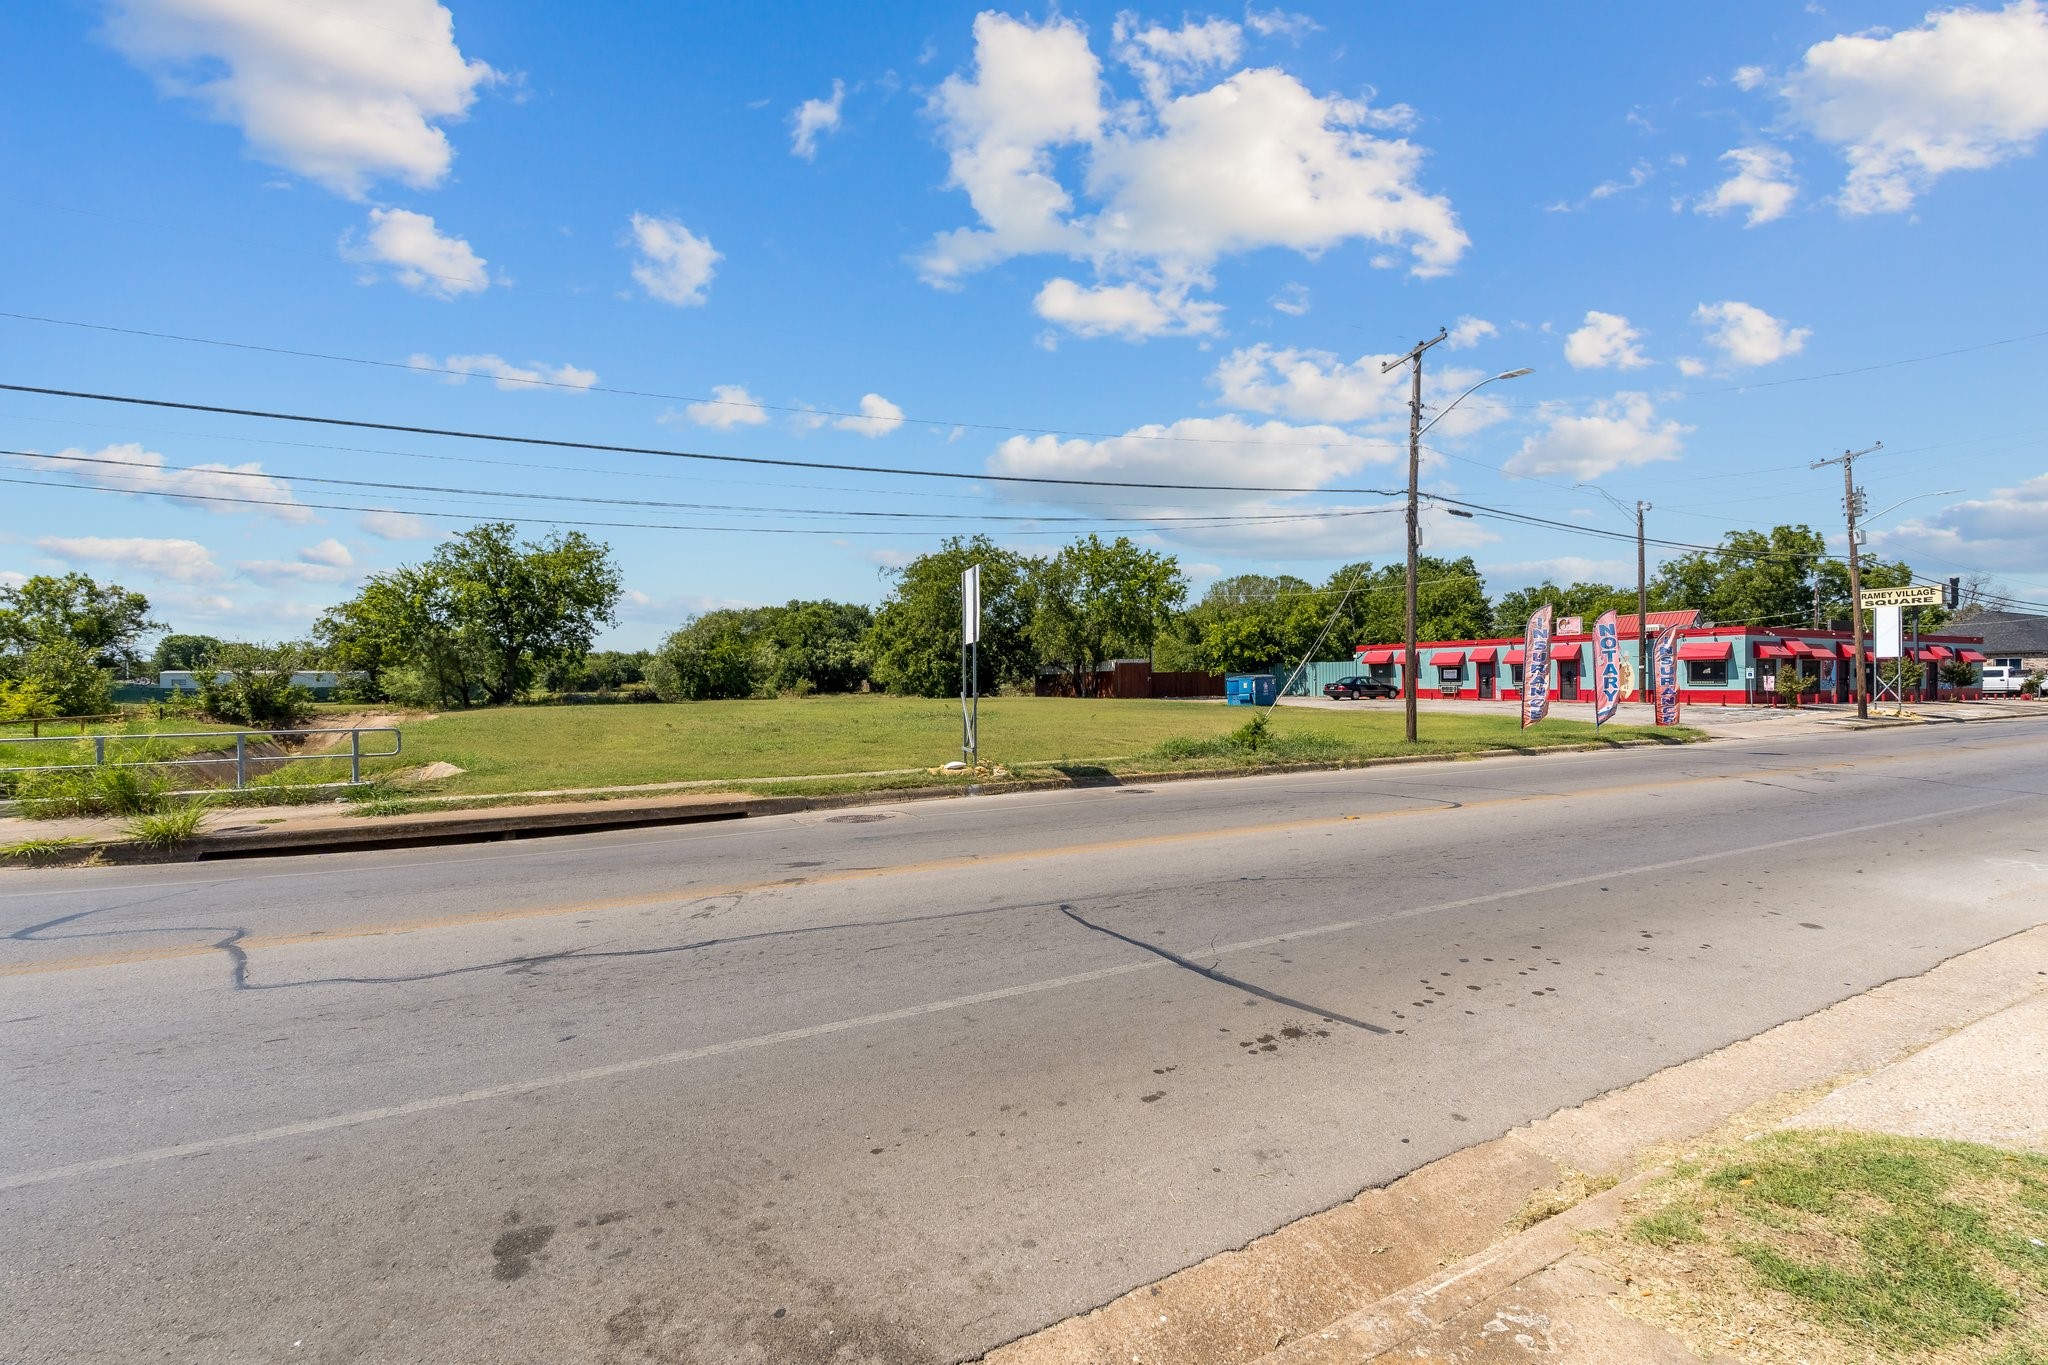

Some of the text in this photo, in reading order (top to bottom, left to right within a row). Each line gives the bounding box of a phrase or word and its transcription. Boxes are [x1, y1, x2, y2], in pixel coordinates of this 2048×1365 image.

[1861, 588, 1936, 600] RAMEY VILLAGE
[1865, 597, 1933, 606] SQUARE
[1529, 617, 1547, 719] INSURANCE
[1598, 623, 1619, 702] NOTARY
[1660, 637, 1677, 723] INSURANCE
